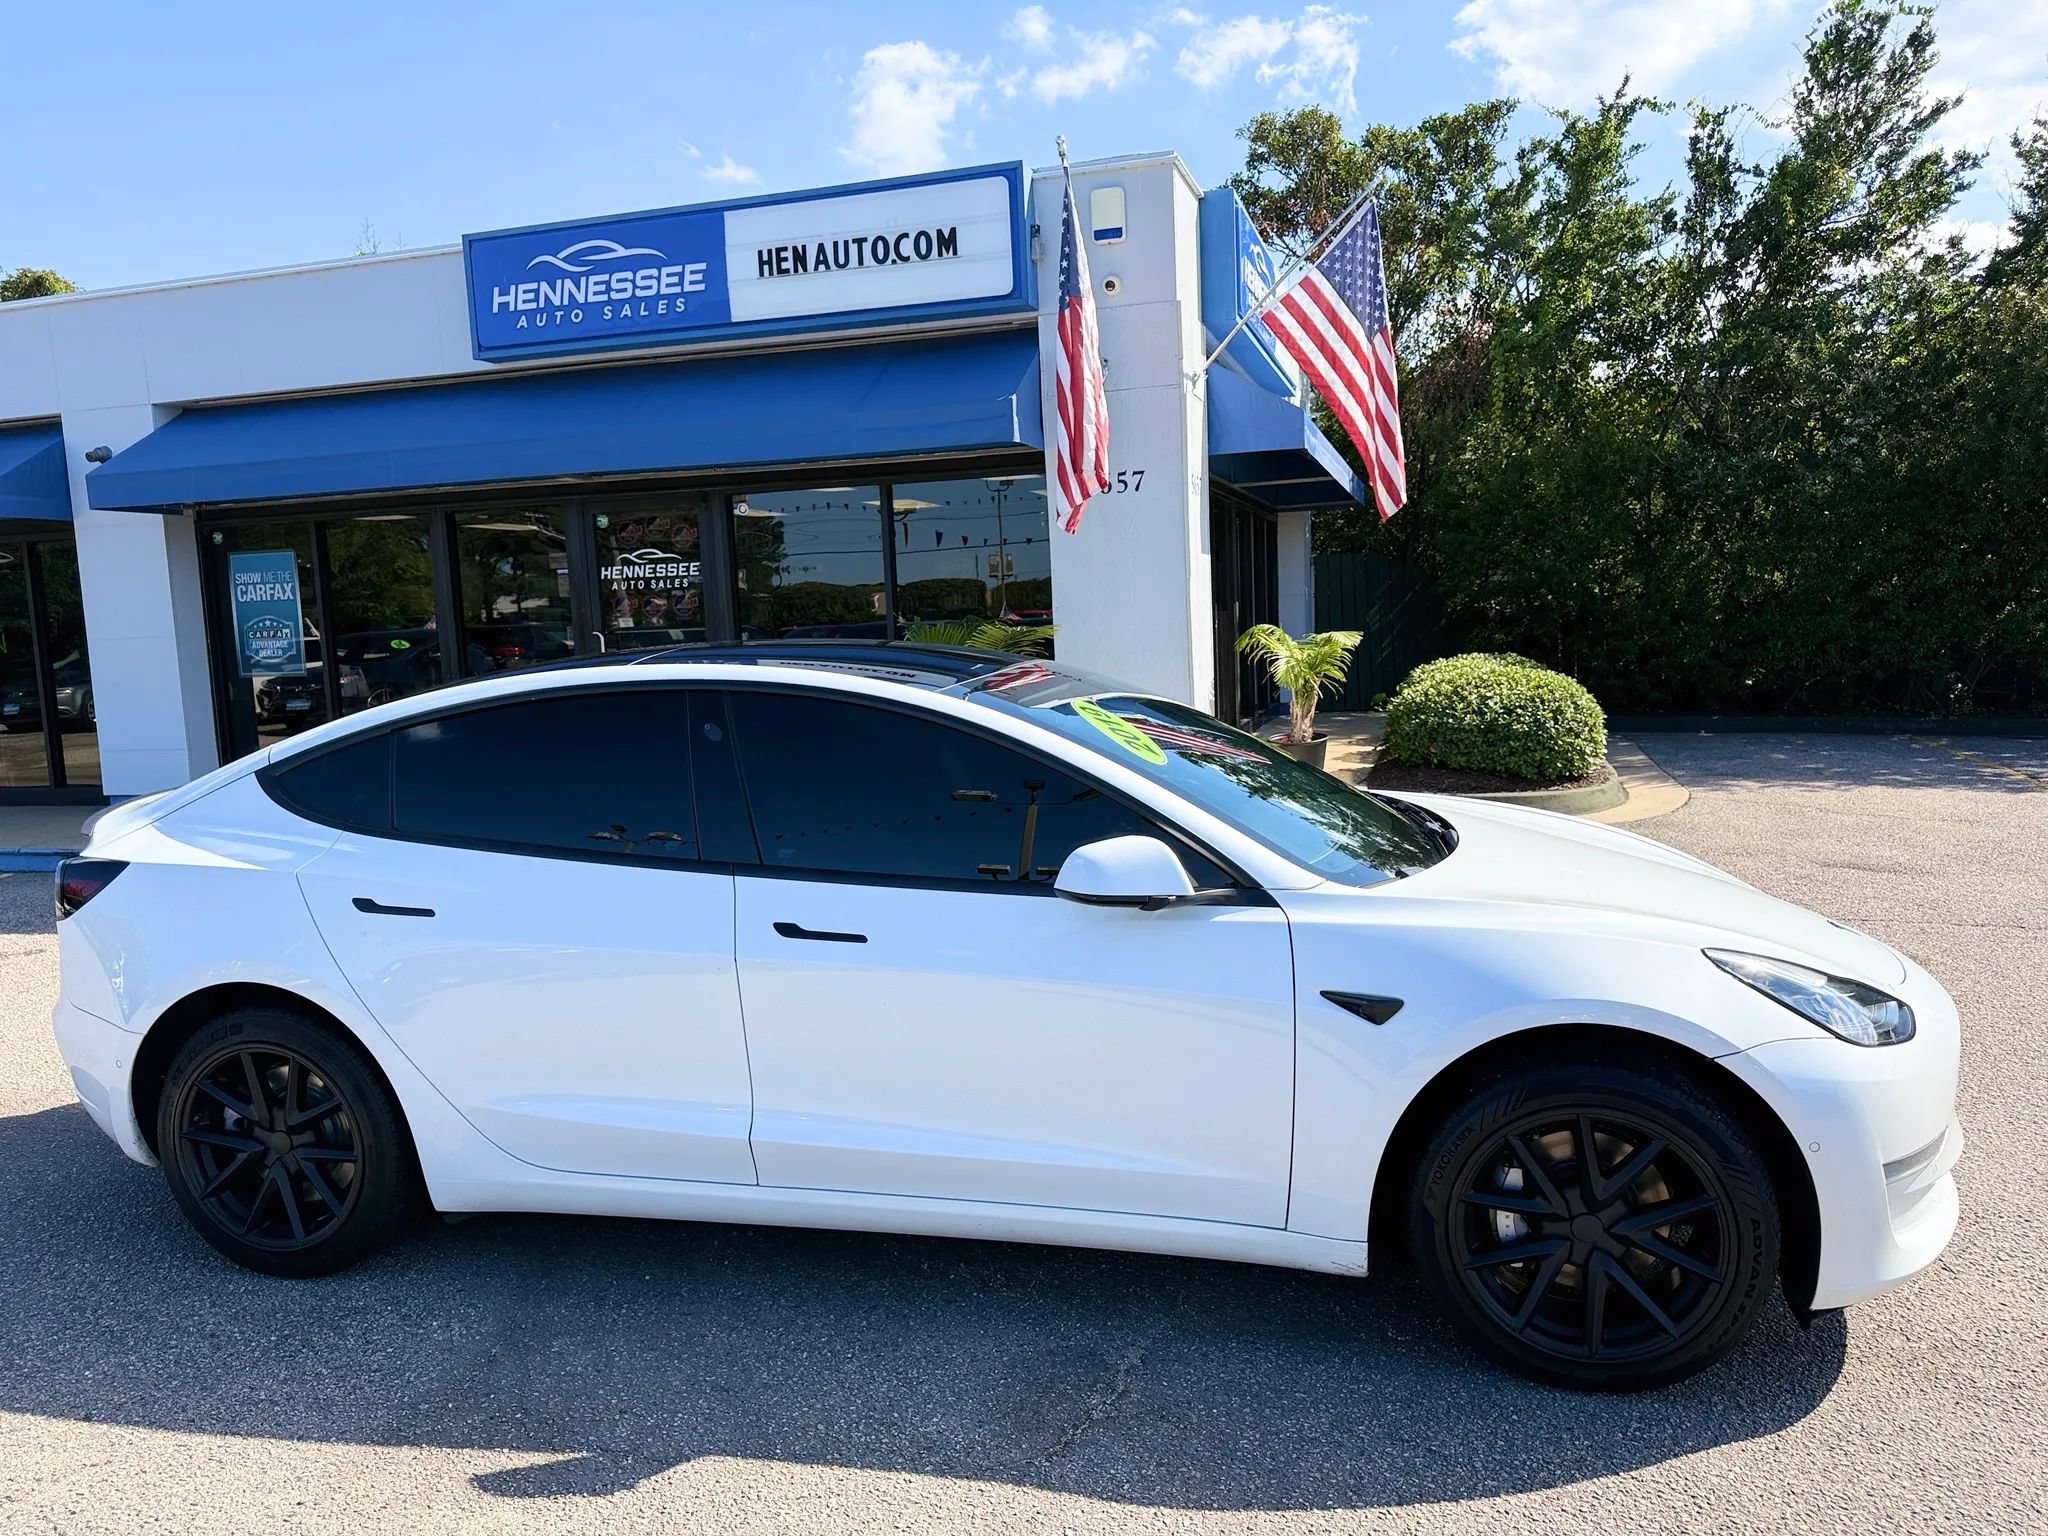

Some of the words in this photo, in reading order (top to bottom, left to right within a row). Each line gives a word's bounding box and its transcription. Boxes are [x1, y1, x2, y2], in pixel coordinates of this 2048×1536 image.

[757, 226, 959, 278] HENAUTO.COM
[492, 262, 707, 314] HENNESSEE
[516, 308, 583, 329] AUTO
[603, 297, 686, 320] SALES
[235, 571, 262, 585] SHOW
[263, 571, 276, 583] ME
[277, 570, 293, 582] THE
[601, 562, 700, 579] HENNESSEE
[236, 582, 295, 602] CARFAX
[612, 580, 645, 591] AUTO
[650, 578, 689, 589] SALES
[248, 628, 291, 639] CARFAX
[251, 639, 289, 649] ADVANTAGE
[258, 648, 283, 658] DEALER
[1429, 1125, 1476, 1187] YOKOHAMA
[1743, 1216, 1764, 1299] ADVAN
